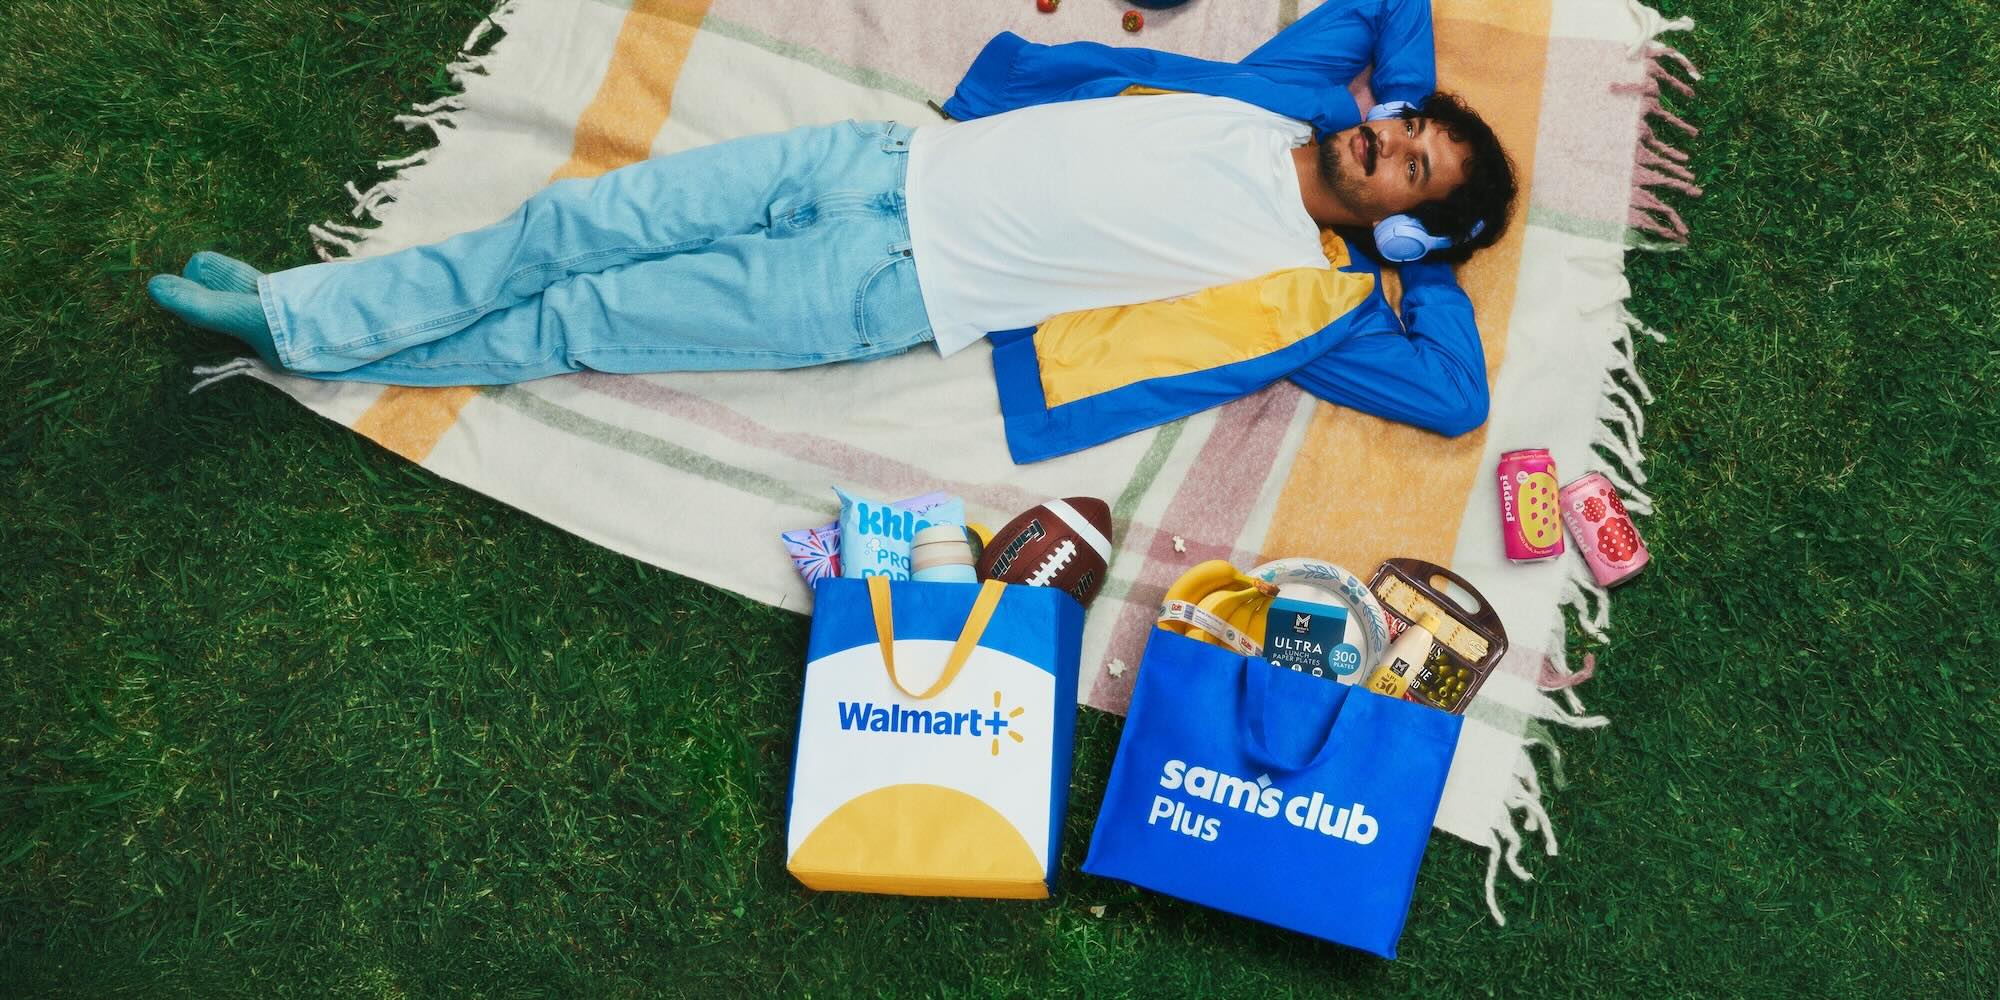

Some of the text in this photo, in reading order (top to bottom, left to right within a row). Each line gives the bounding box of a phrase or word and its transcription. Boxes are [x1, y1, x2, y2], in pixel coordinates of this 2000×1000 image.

[1500, 474, 1515, 522] poppi
[1274, 636, 1323, 655] ULTRA
[1284, 650, 1310, 659] LUNCH
[1272, 652, 1321, 667] PAPER PLATES
[1332, 650, 1358, 664] 300
[1333, 661, 1355, 670] PLATES
[1375, 676, 1398, 696] 50
[1147, 795, 1222, 842] Plus
[1285, 792, 1379, 845] club
